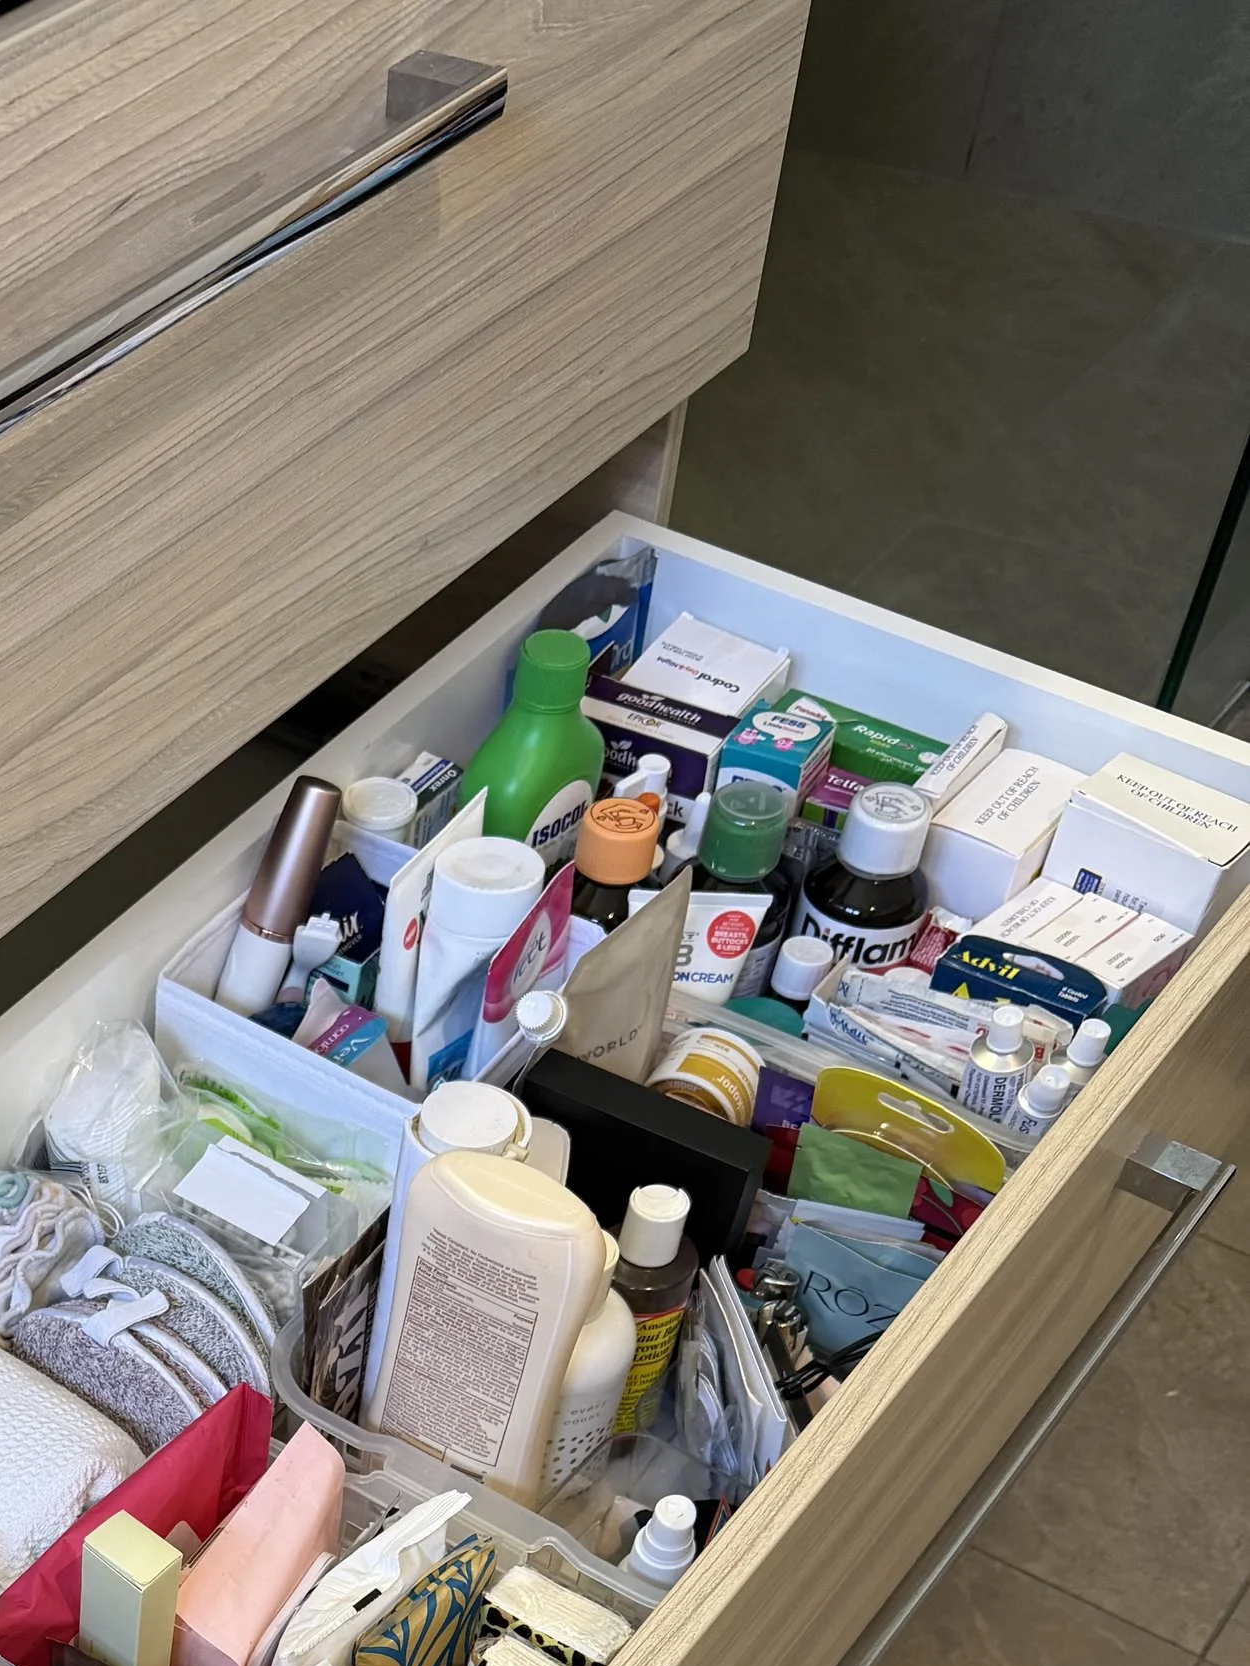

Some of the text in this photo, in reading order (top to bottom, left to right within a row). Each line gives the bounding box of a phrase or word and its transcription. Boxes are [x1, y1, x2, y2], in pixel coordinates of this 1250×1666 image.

[656, 656, 678, 669] Night
[700, 672, 741, 694] Codral
[853, 724, 899, 744] Rapid
[954, 735, 979, 765] CHILDREN
[974, 766, 1040, 826] KEEP OUT OF REACH
[997, 780, 1041, 821] OF CHILDREN
[1116, 774, 1239, 833] KEEP OUT OF REACH
[1130, 788, 1212, 829] OF CHILDREN
[710, 936, 749, 945] BUTTOCKS
[714, 929, 748, 939] BREASTS,
[800, 912, 917, 965] Difflam
[960, 950, 1021, 980] Advil
[691, 972, 734, 984] CREAM
[1058, 990, 1080, 1003] Tablets
[1067, 987, 1089, 999] Coated
[635, 1335, 675, 1353] rowni
[633, 1346, 670, 1362] Lotion
[569, 1399, 607, 1416] every
